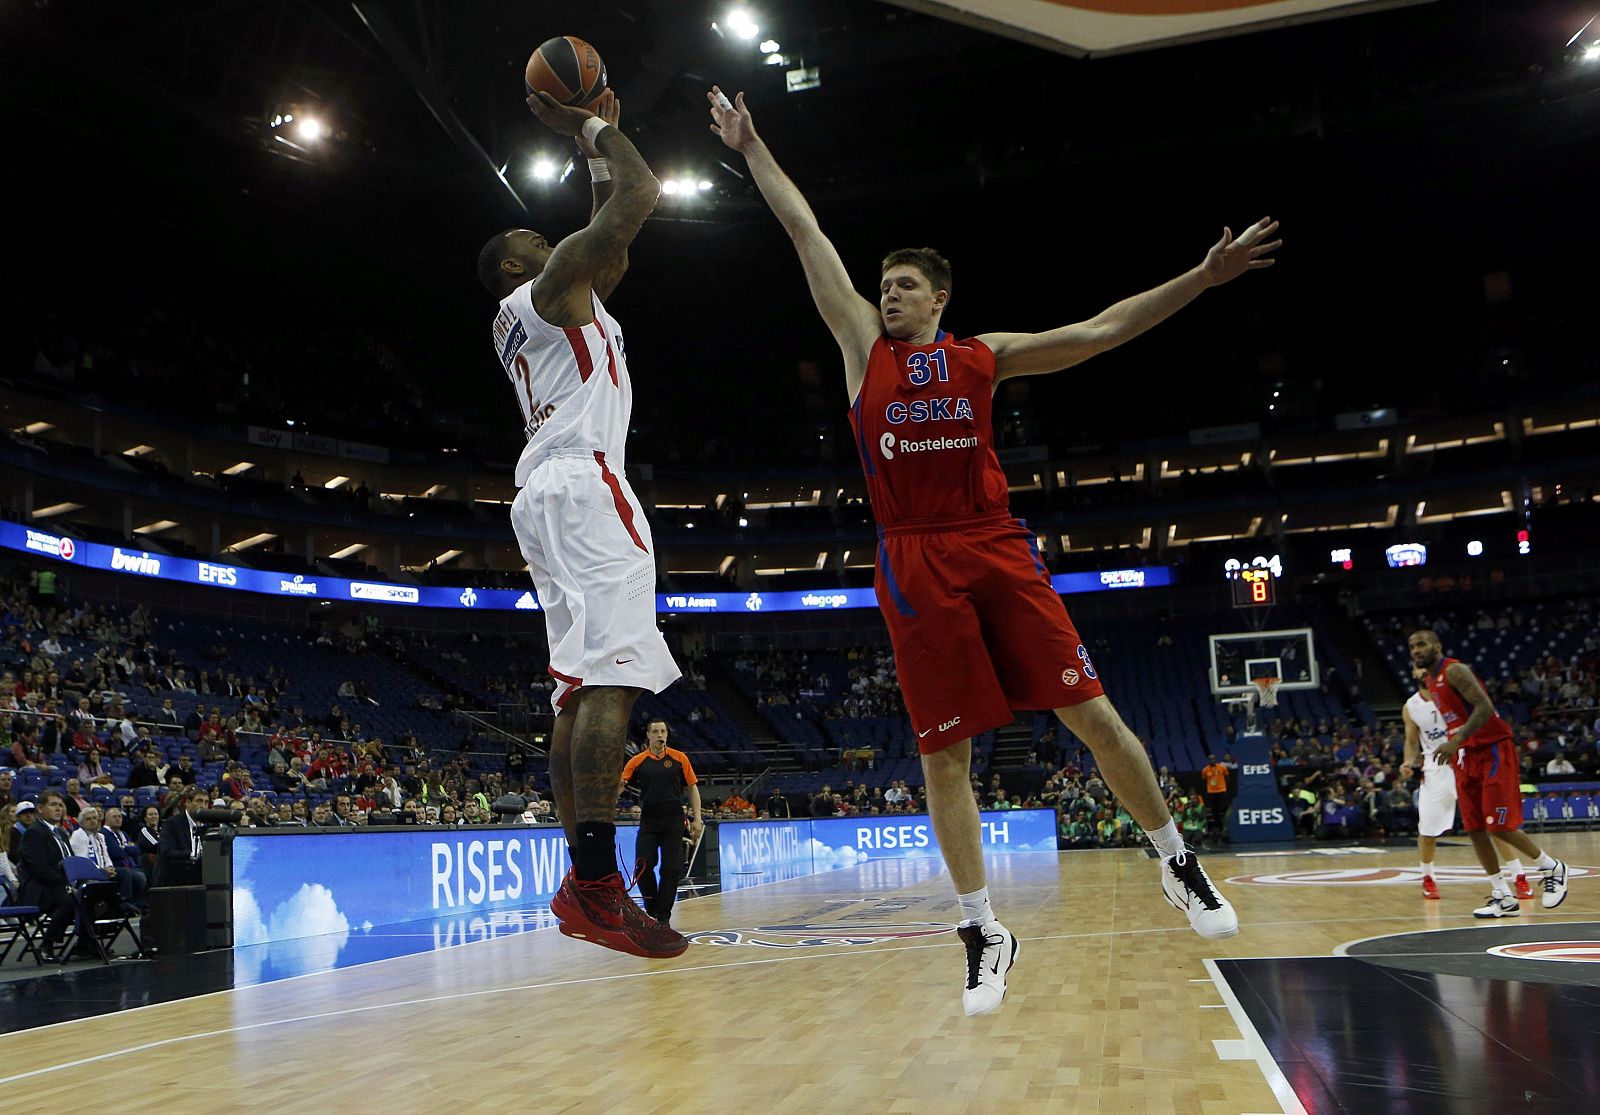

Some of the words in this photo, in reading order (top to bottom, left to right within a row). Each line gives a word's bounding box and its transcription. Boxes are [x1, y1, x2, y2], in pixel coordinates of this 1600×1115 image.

[907, 348, 949, 385] 31
[885, 397, 974, 424] CSKA
[900, 436, 978, 453] Rostelecom
[111, 548, 160, 575] bwin
[198, 563, 237, 586] EFES
[665, 596, 687, 608] VTB
[687, 596, 717, 608] Arena
[801, 593, 848, 608] viagogo
[1253, 582, 1266, 602] 8
[938, 716, 961, 732] UAC
[1243, 763, 1270, 775] EFES
[1238, 807, 1284, 825] EFES
[1496, 806, 1508, 825] 7
[740, 827, 771, 866] RISES
[771, 826, 800, 860] WITH
[856, 825, 929, 850] RISES
[980, 822, 1009, 844] TH
[431, 838, 523, 910] RISES
[530, 837, 570, 896] WI
